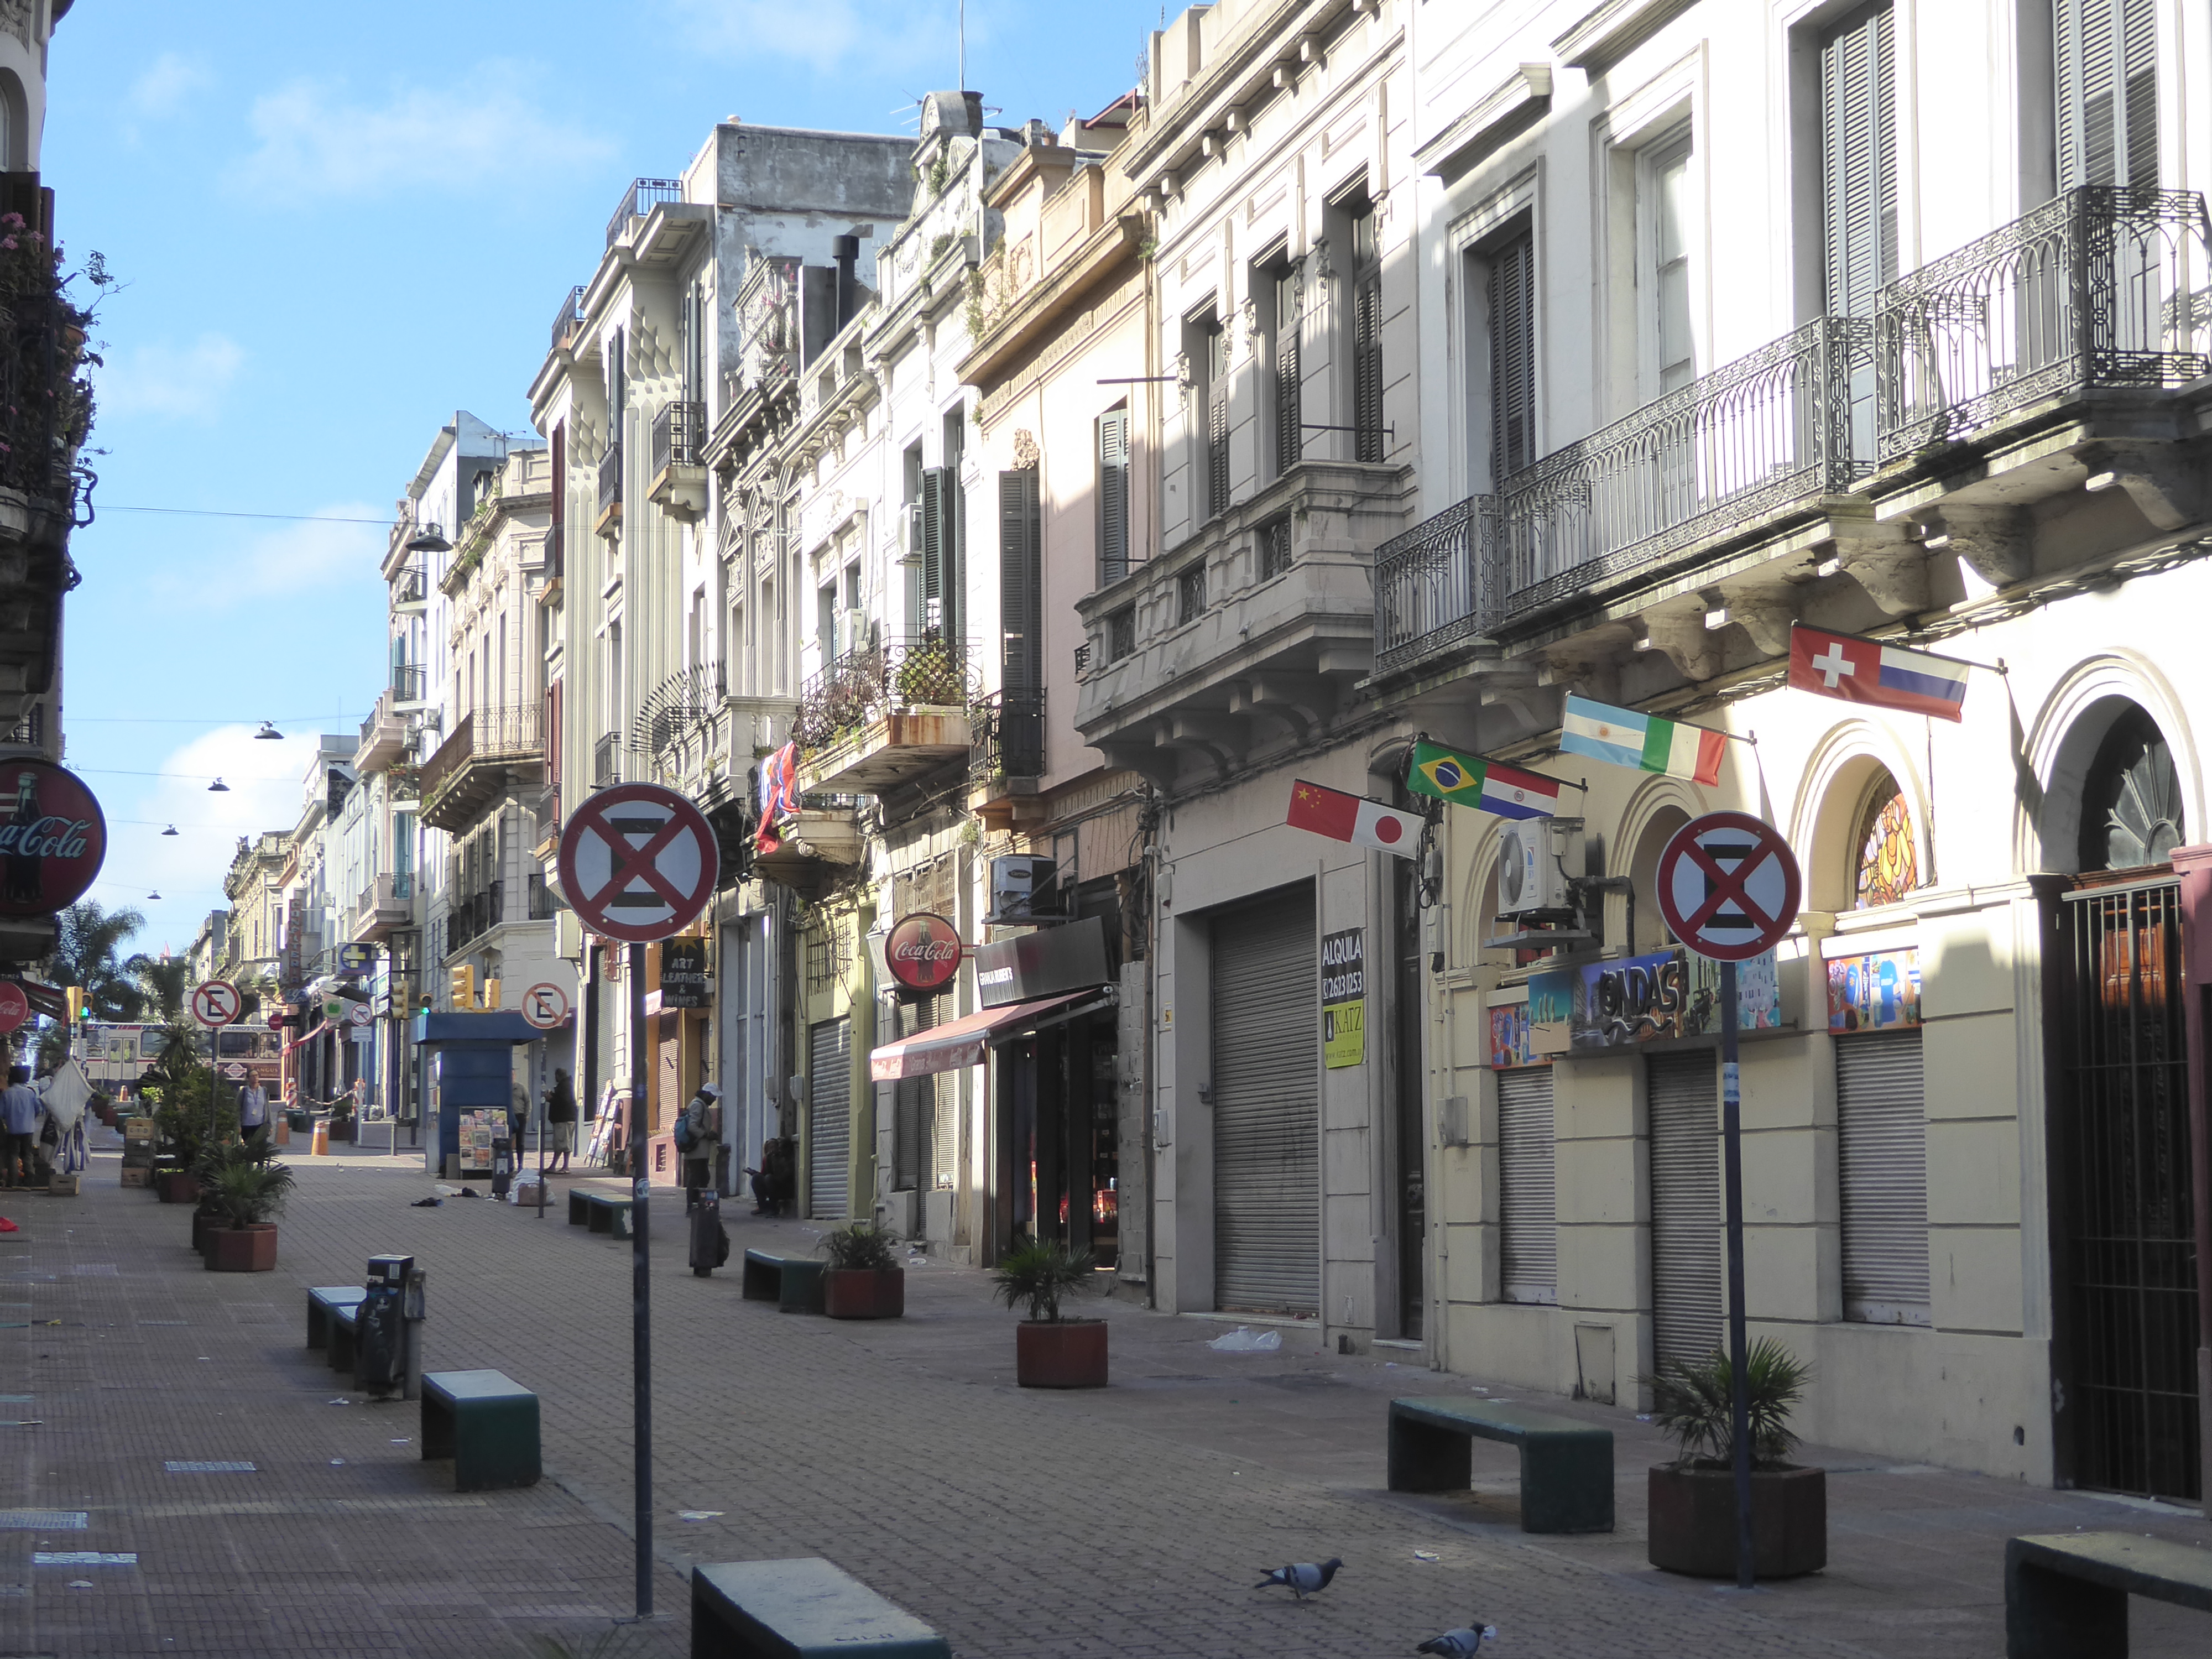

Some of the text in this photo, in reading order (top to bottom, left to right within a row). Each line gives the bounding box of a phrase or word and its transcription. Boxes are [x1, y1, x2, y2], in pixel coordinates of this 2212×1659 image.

[894, 940, 955, 962] Coca-Cola
[1322, 933, 1362, 966] ALQUILA
[672, 957, 694, 969] ART
[662, 972, 704, 984] LEATHER
[679, 984, 686, 994] &
[1599, 961, 1679, 1018] ONDAS
[1335, 1006, 1361, 1034] KATZ
